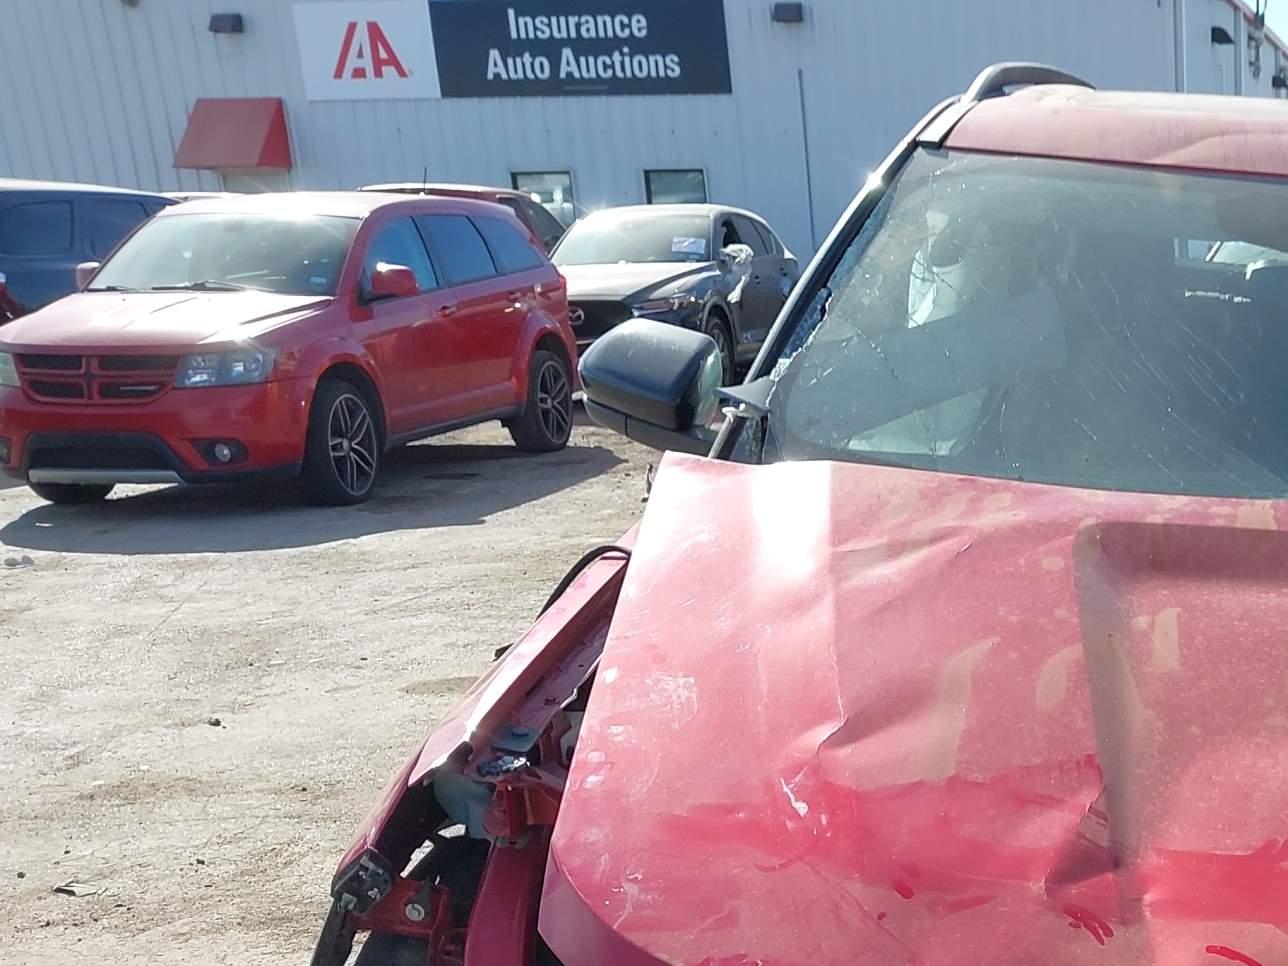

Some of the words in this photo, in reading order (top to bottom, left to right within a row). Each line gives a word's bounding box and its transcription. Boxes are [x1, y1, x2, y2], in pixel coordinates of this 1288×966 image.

[508, 8, 648, 40] Insurance
[486, 49, 551, 81] Auto
[559, 47, 681, 79] Auctions
